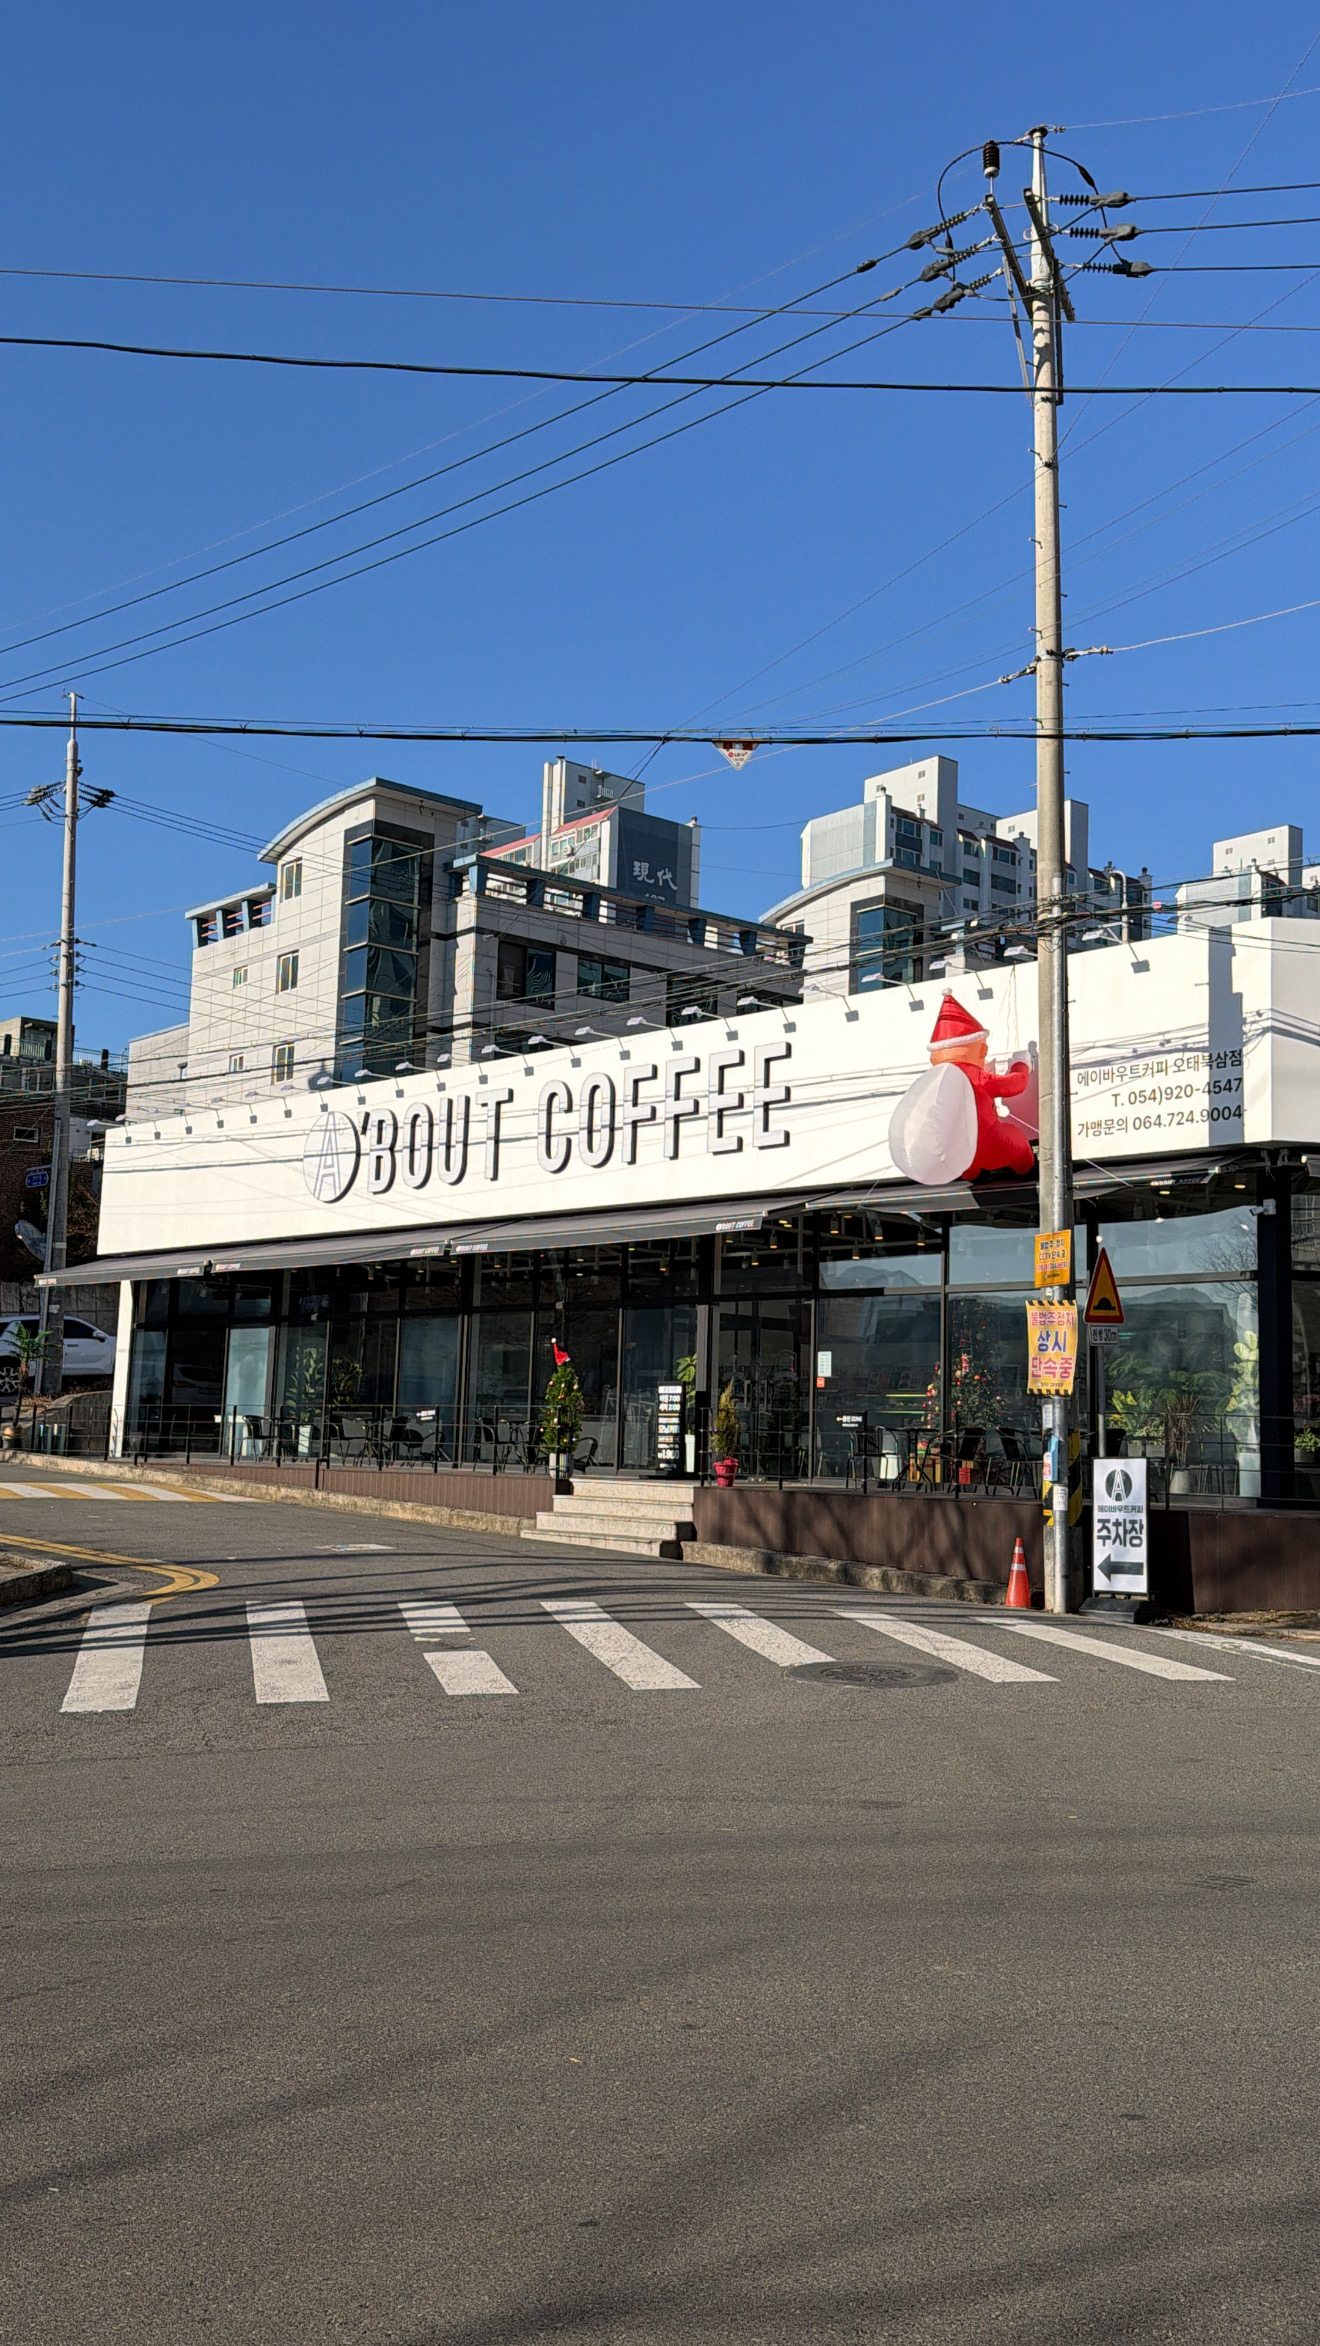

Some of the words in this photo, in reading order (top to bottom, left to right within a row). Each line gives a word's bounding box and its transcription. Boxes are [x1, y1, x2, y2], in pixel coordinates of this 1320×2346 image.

[632, 860, 678, 891] 現代
[1077, 1058, 1169, 1087] 에이바우트커피
[1172, 1048, 1243, 1074] 오태북삼점
[1111, 1093, 1124, 1107] T.
[1128, 1077, 1243, 1105] 054)920-4547
[537, 1041, 792, 1174] COFFEE
[1077, 1116, 1128, 1138] 가맹문의
[1132, 1105, 1243, 1131] 064.724.9004
[1037, 1329, 1067, 1353] 상시
[1031, 1356, 1073, 1379] 단속중
[1097, 1504, 1144, 1514] 에이바우트커피
[1096, 1518, 1144, 1547] 주차장
